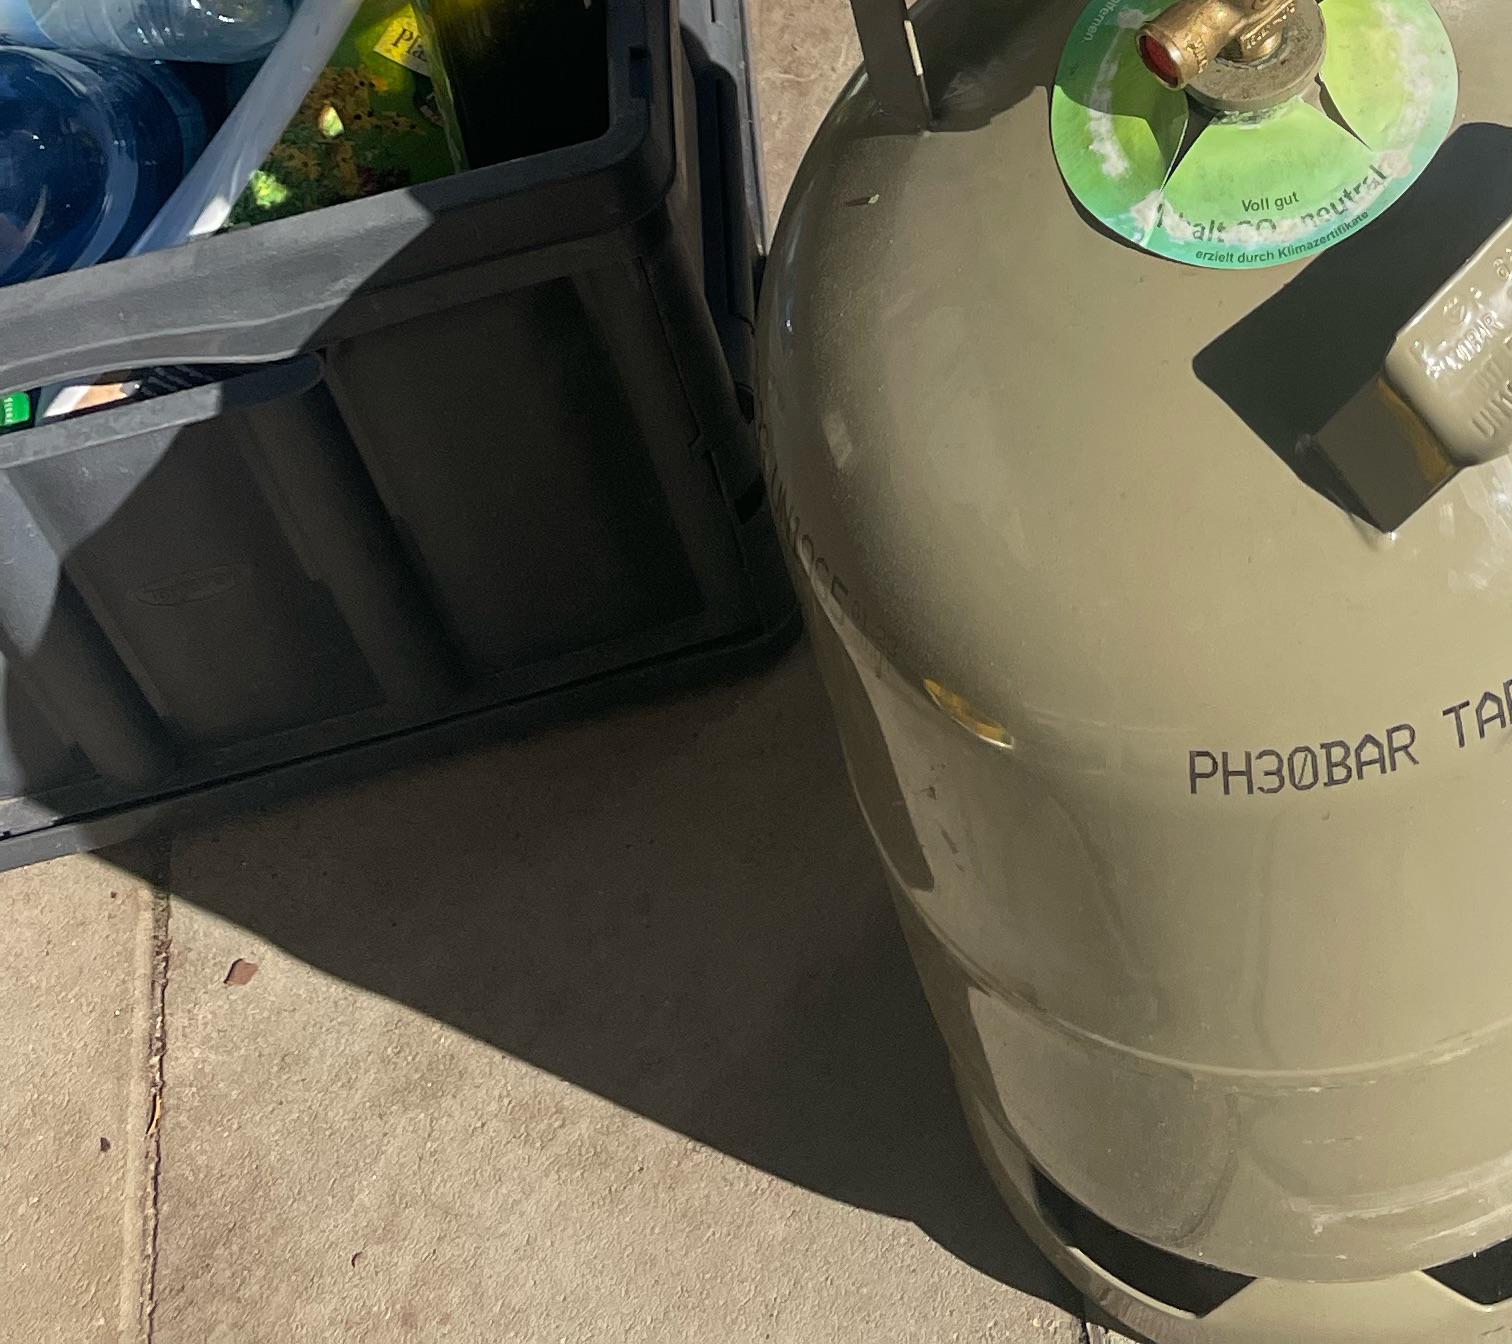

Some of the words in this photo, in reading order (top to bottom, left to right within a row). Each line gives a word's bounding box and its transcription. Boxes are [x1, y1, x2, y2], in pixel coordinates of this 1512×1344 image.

[1241, 196, 1270, 213] Voll
[1274, 191, 1300, 211] gut
[1195, 249, 1234, 263] erzielt
[1237, 250, 1275, 264] durch
[1277, 209, 1370, 258] Klimazertifikate
[1187, 722, 1420, 796] PH30BAR
